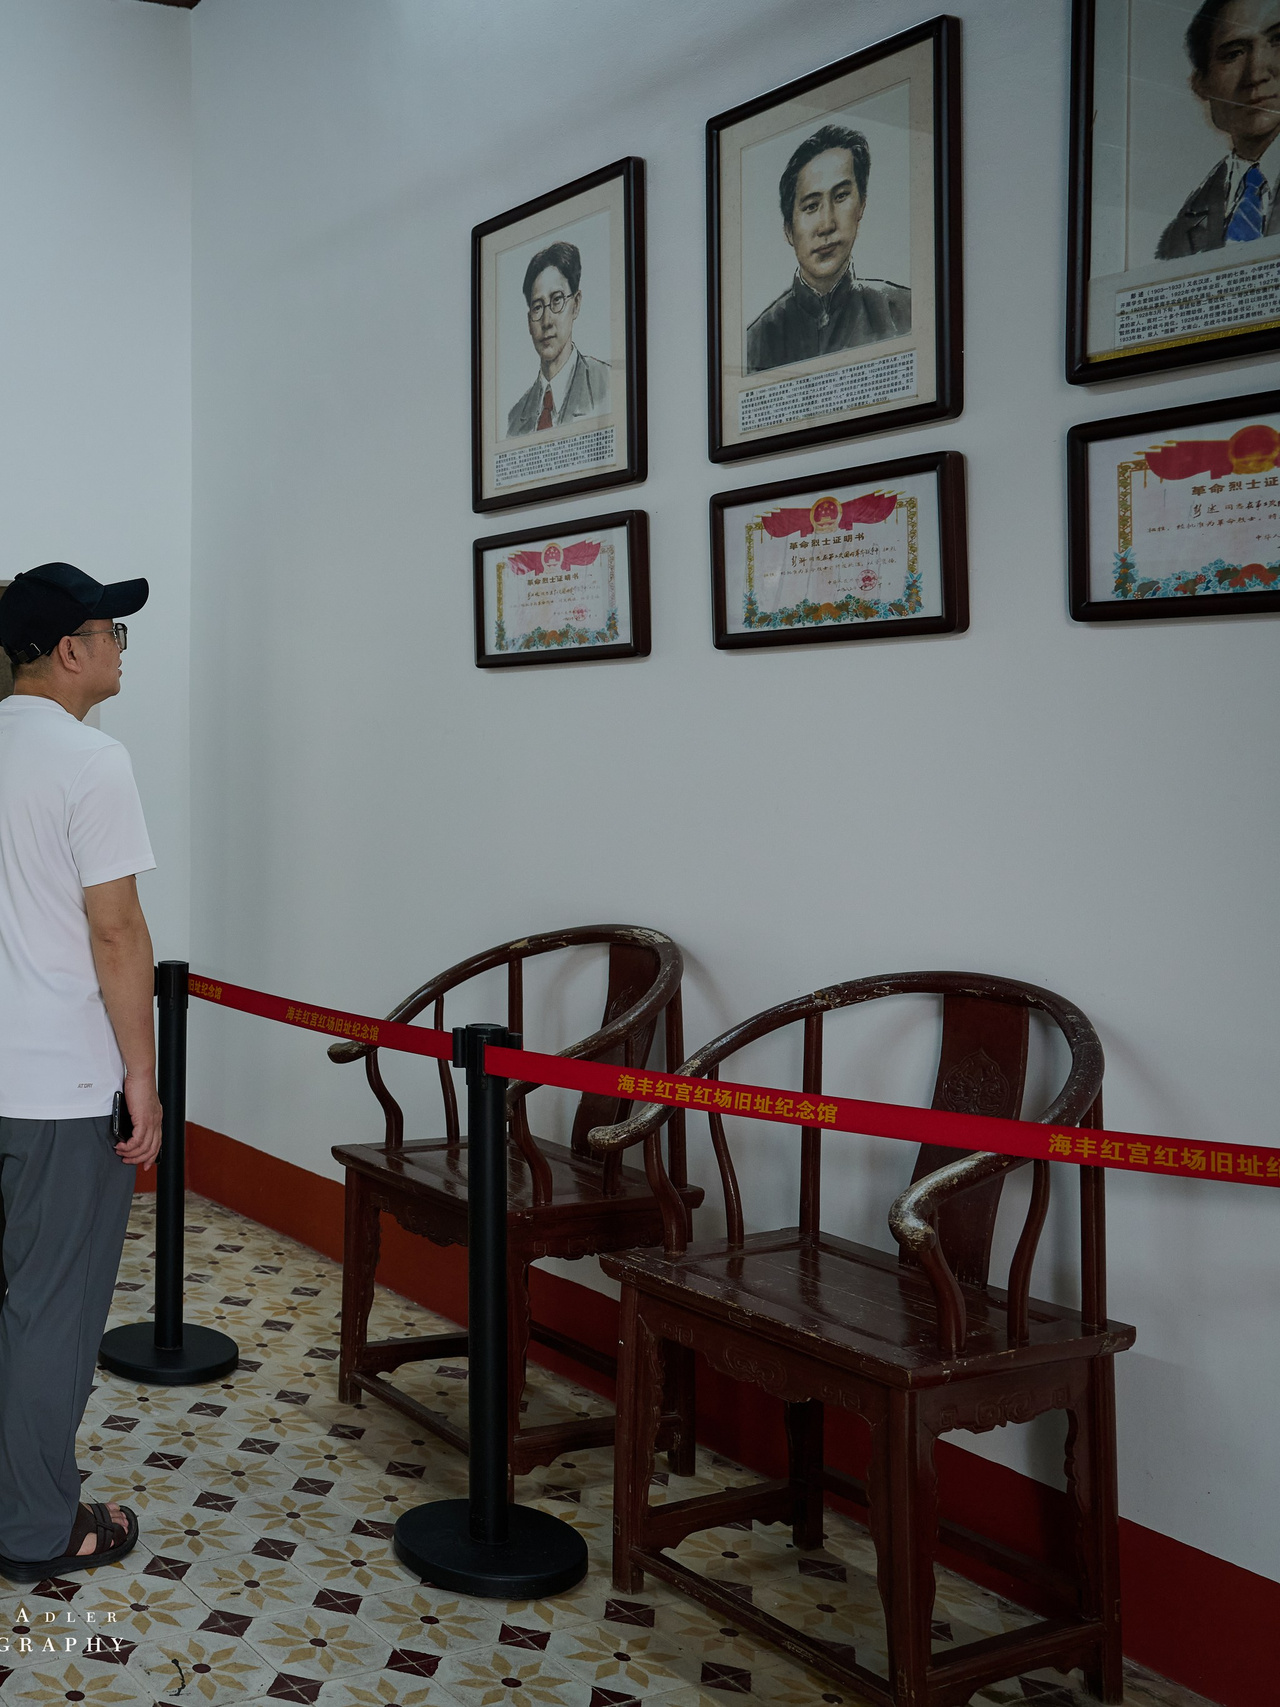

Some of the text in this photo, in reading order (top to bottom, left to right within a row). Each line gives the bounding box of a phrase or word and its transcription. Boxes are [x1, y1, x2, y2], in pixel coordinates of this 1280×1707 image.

[285, 1005, 380, 1041] 海丰红宫红场旧址纪念馆
[616, 1073, 839, 1124] 海丰红宫红场旧址纪念馆
